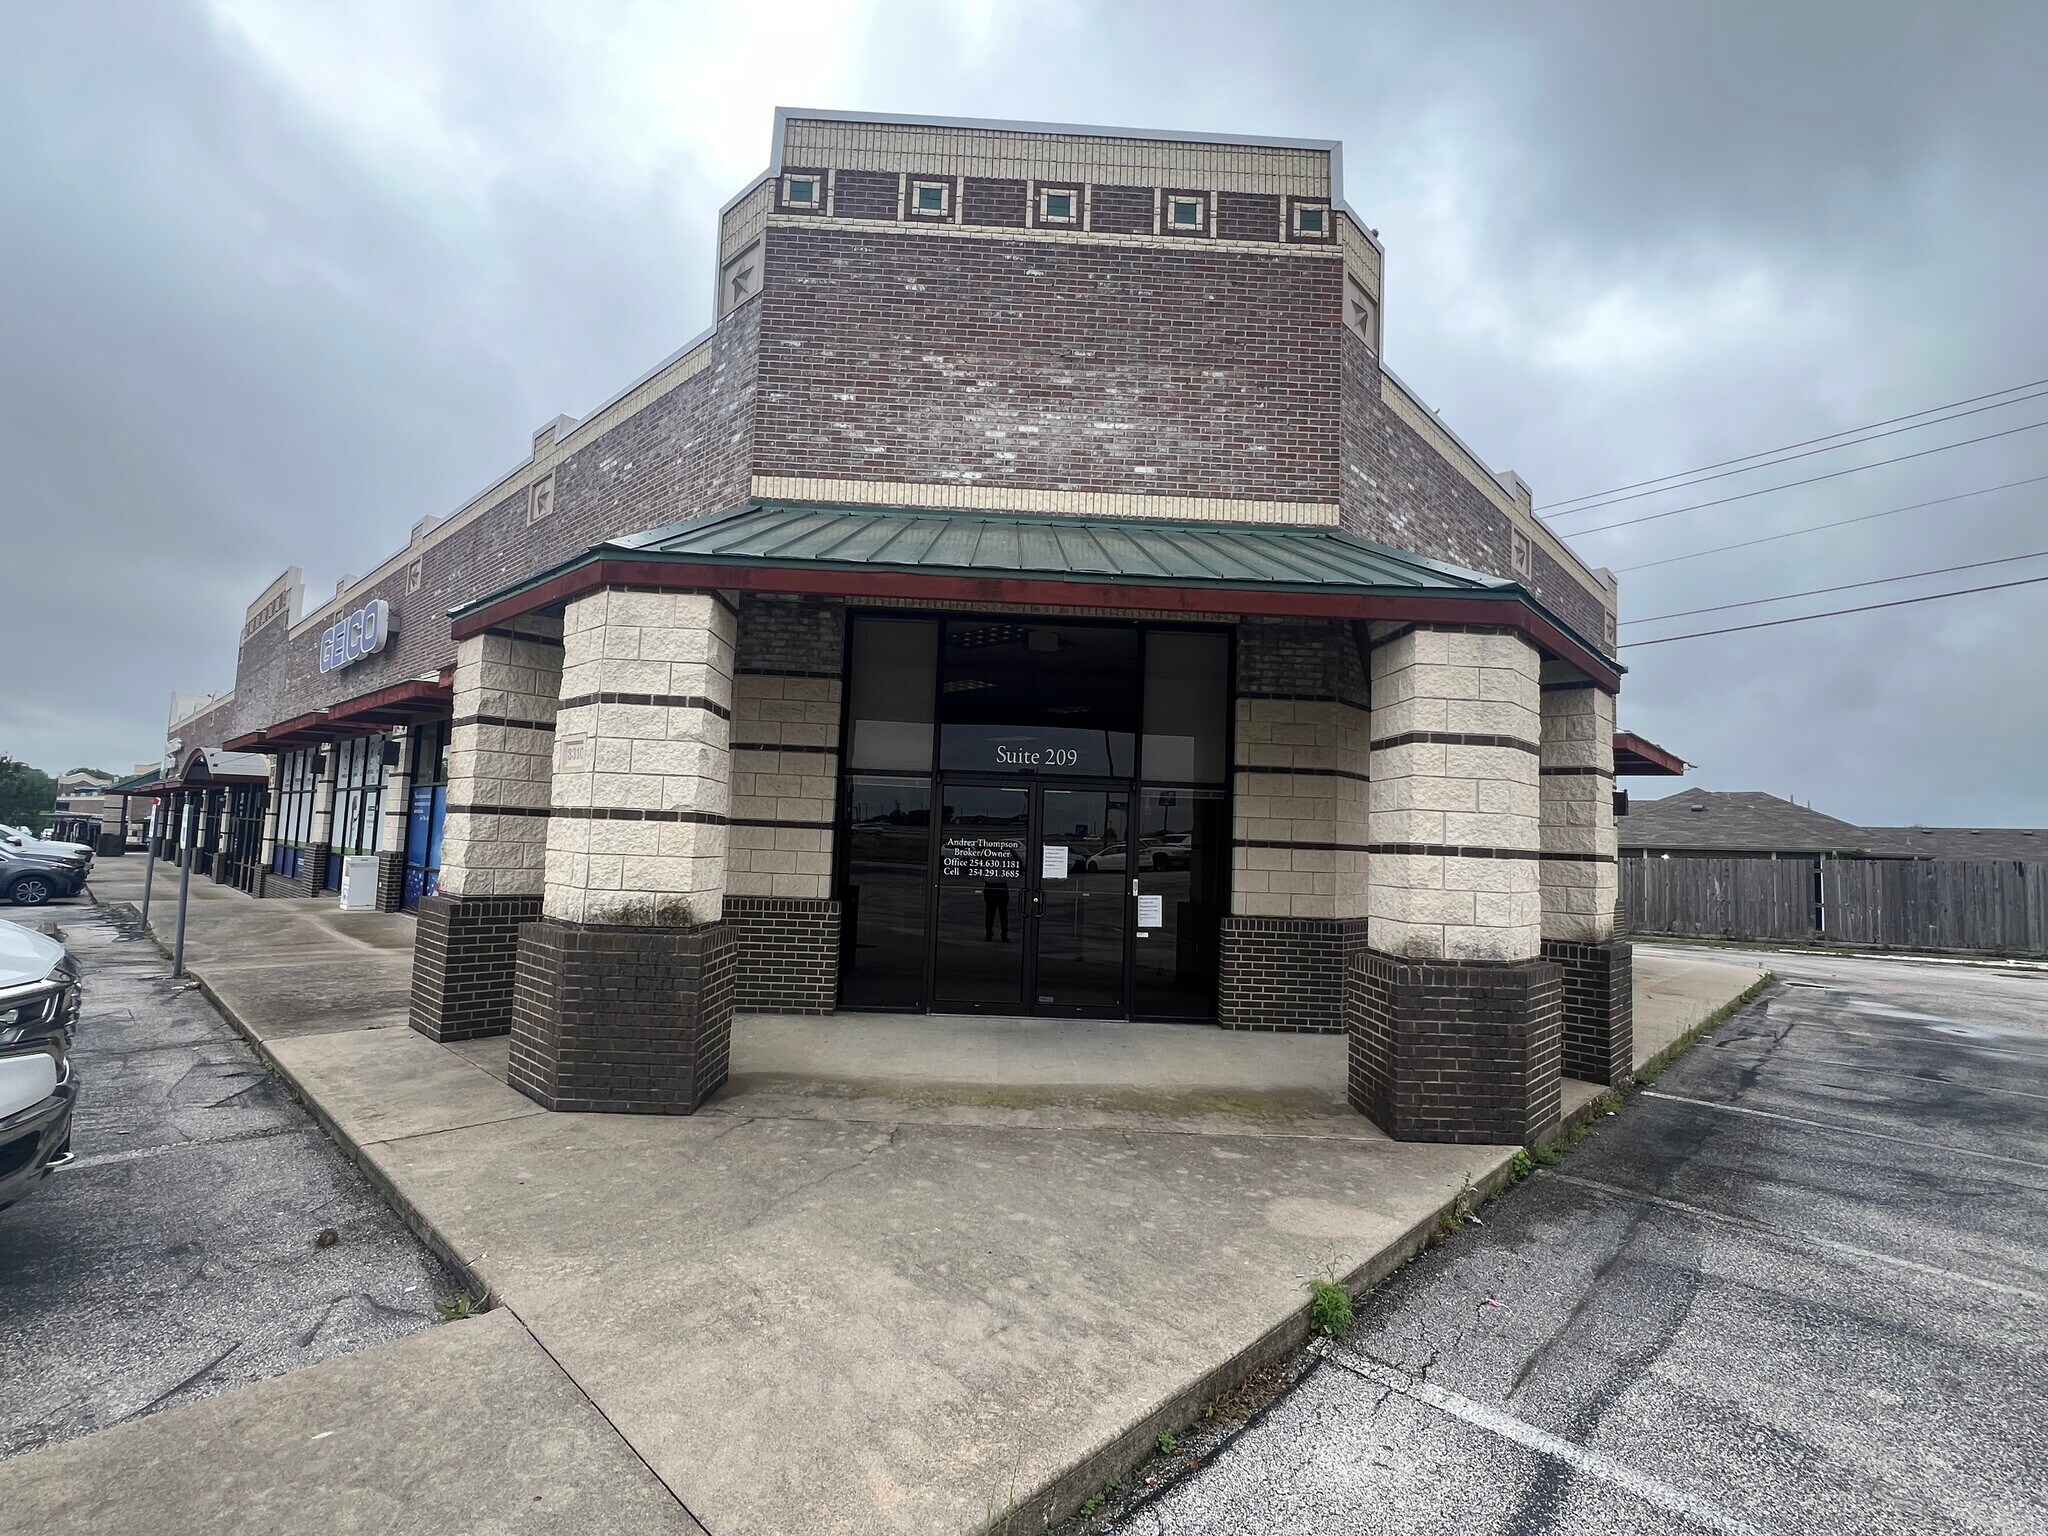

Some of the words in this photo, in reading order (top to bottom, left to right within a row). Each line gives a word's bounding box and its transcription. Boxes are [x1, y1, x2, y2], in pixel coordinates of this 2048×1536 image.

[320, 599, 382, 673] GEICO
[996, 745, 1040, 764] Suite
[1044, 748, 1078, 766] 209
[947, 838, 976, 847] Andrea
[977, 839, 1019, 850] Thompson
[954, 847, 1011, 858] Broker/Owner
[943, 857, 968, 867] Office
[969, 859, 1020, 869] 254.630.1181
[943, 867, 960, 876] Cell
[968, 868, 1020, 878] 254.291.3685
